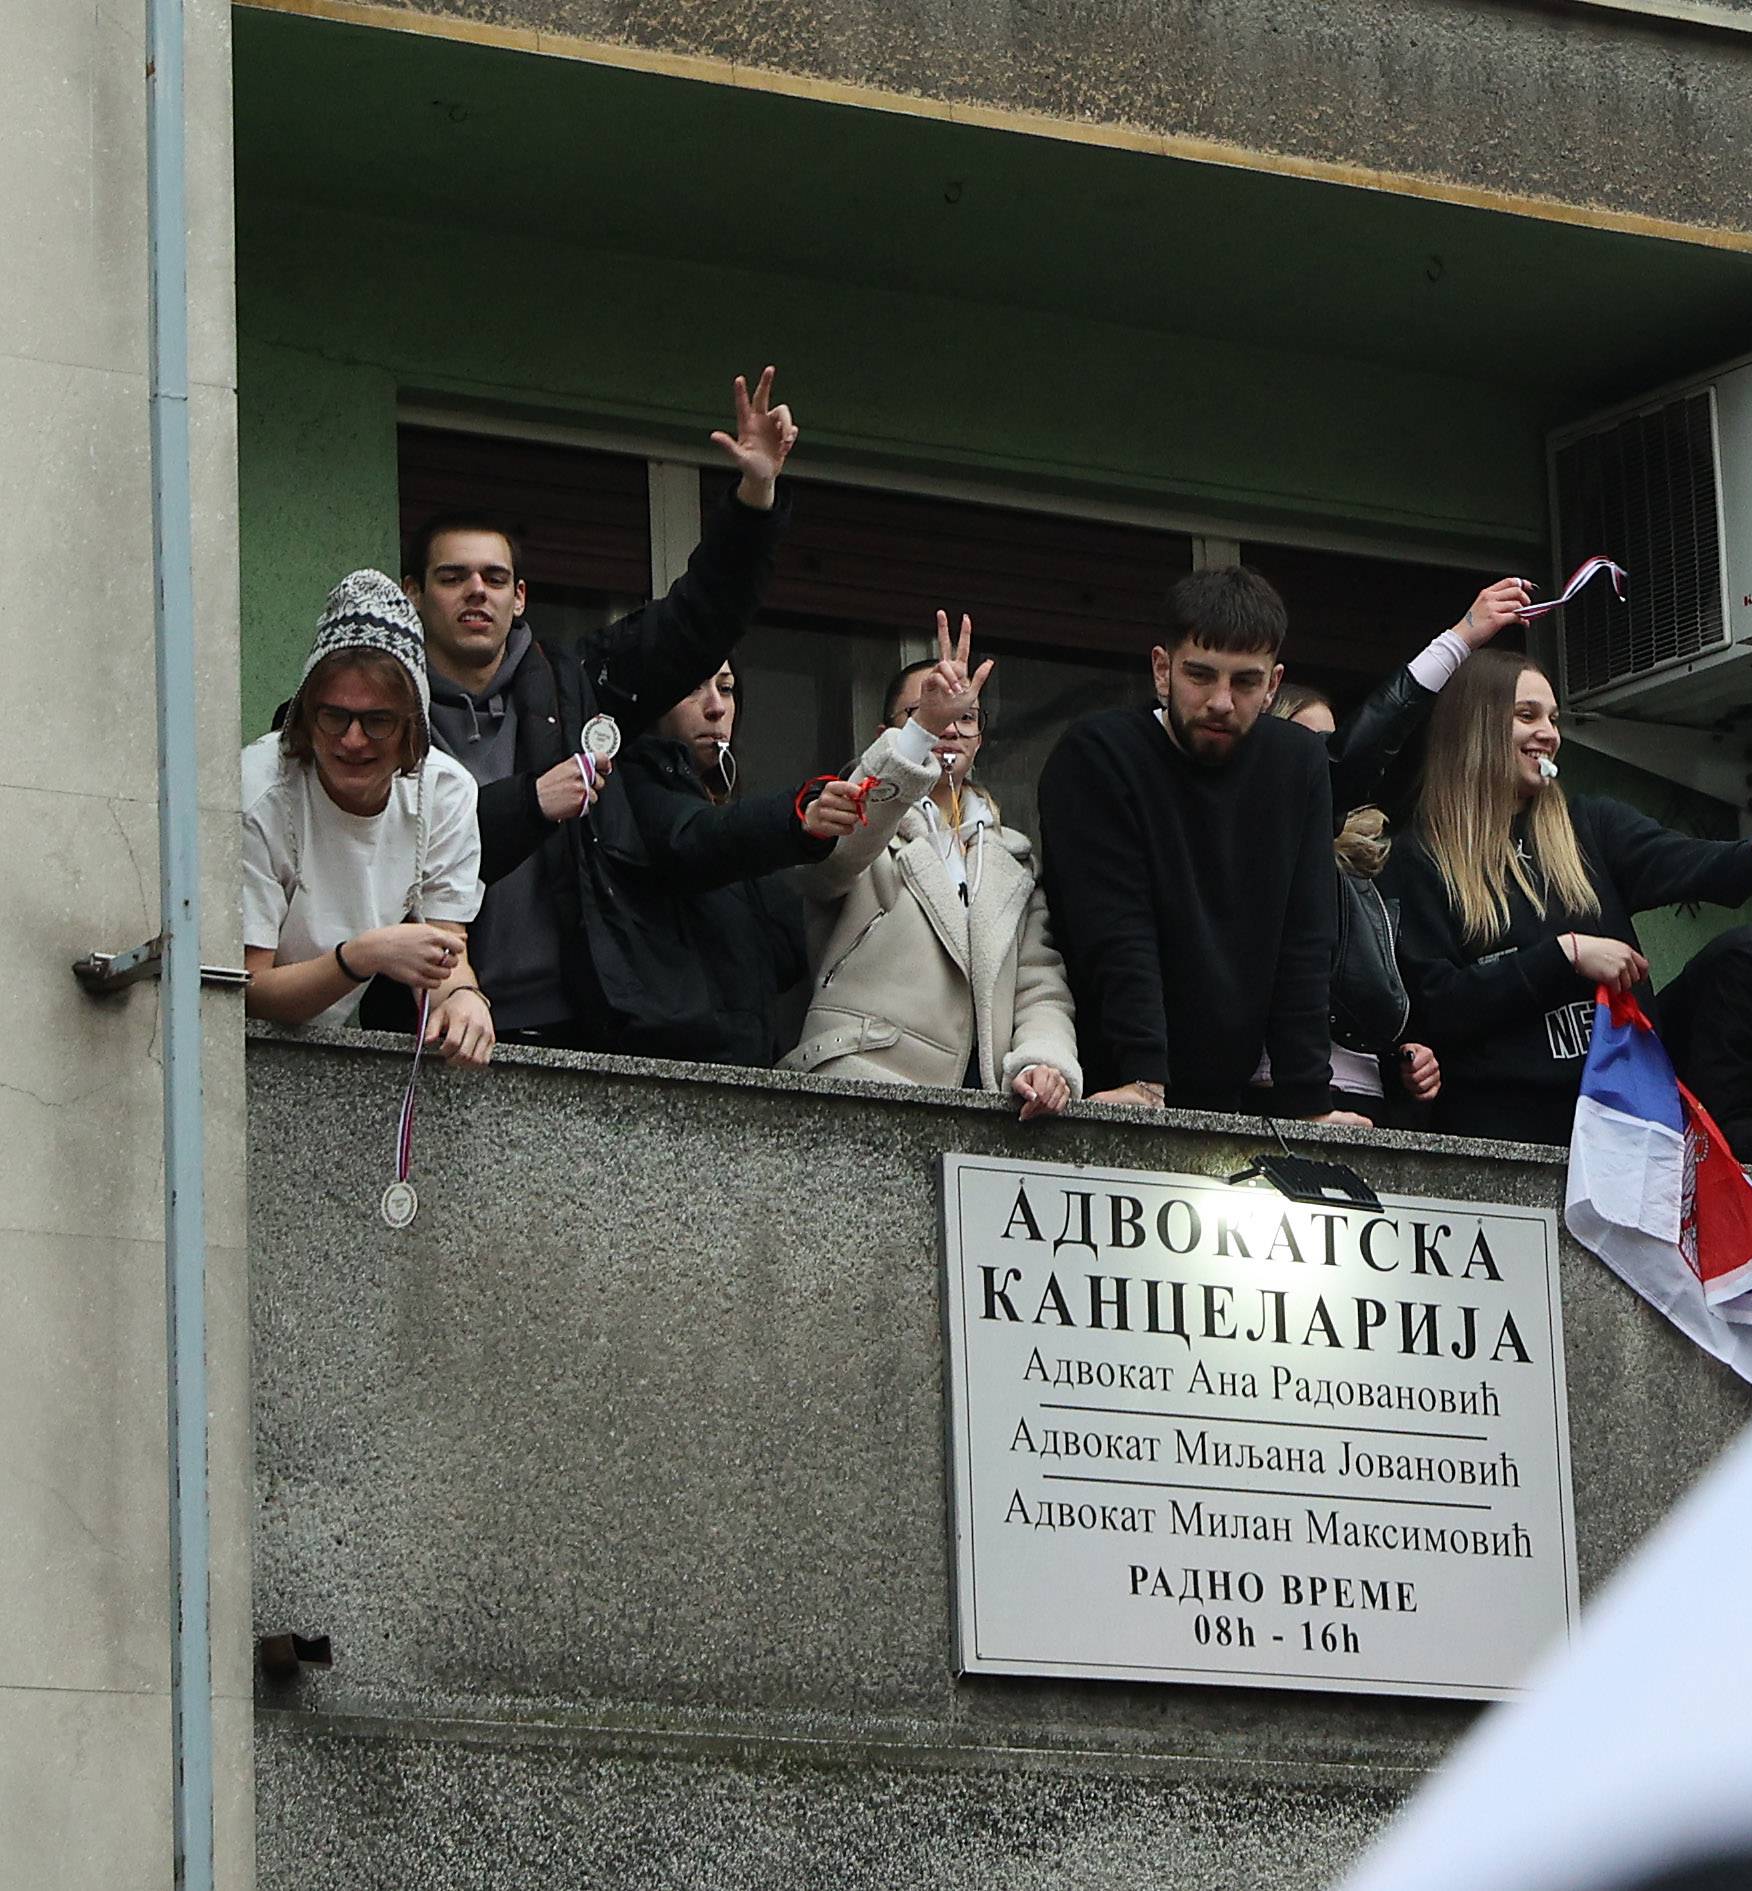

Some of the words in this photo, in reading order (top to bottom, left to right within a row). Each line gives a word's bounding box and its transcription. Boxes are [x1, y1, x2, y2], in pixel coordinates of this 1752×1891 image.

[1545, 1000, 1595, 1059] NE
[1000, 1185, 1504, 1282] АДВОКАТСКА
[977, 1264, 1534, 1364] КАНЦЕЛАРИЈА
[1023, 1346, 1174, 1392] Адвокат
[1187, 1358, 1260, 1398] Ана
[1270, 1365, 1501, 1417] Радовановић
[1010, 1416, 1161, 1462] Адвокат
[1173, 1428, 1327, 1474] Миљана
[1338, 1441, 1521, 1488] Јовановић
[1004, 1488, 1157, 1534] Адвокат
[1168, 1499, 1293, 1543] Милан
[1304, 1509, 1534, 1559] Максимовић
[1128, 1565, 1264, 1604] РАДНО
[1280, 1574, 1417, 1613] ВРЕМЕ
[1194, 1613, 1256, 1648] 08h
[1300, 1618, 1360, 1654] 16h
